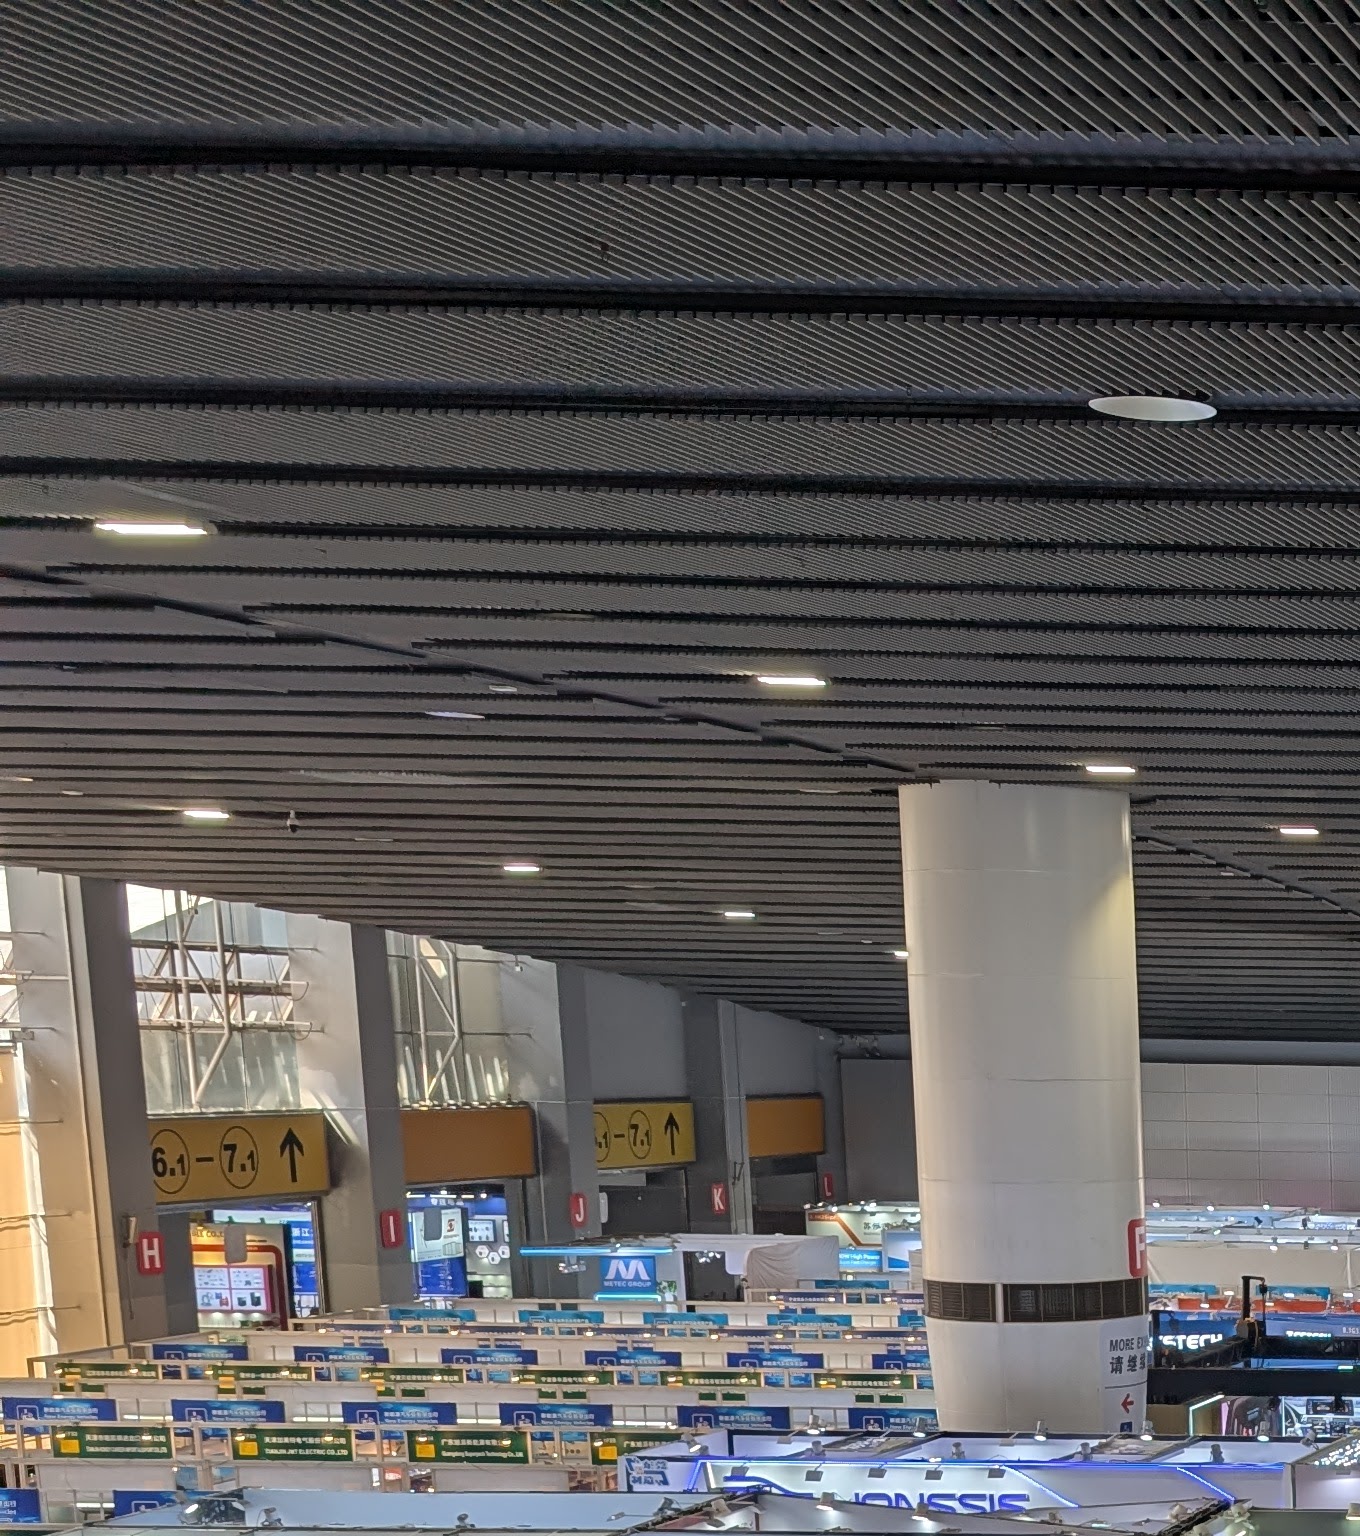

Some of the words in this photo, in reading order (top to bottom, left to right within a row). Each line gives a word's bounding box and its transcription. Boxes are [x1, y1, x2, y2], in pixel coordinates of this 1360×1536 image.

[629, 1123, 652, 1146] 7.1
[151, 1146, 187, 1177] 6.1
[222, 1143, 259, 1174] 7.1
[713, 1186, 725, 1211] K
[824, 1178, 832, 1197] L
[575, 1198, 584, 1223] J
[142, 1238, 162, 1268] H
[1109, 1339, 1135, 1352] MORE
